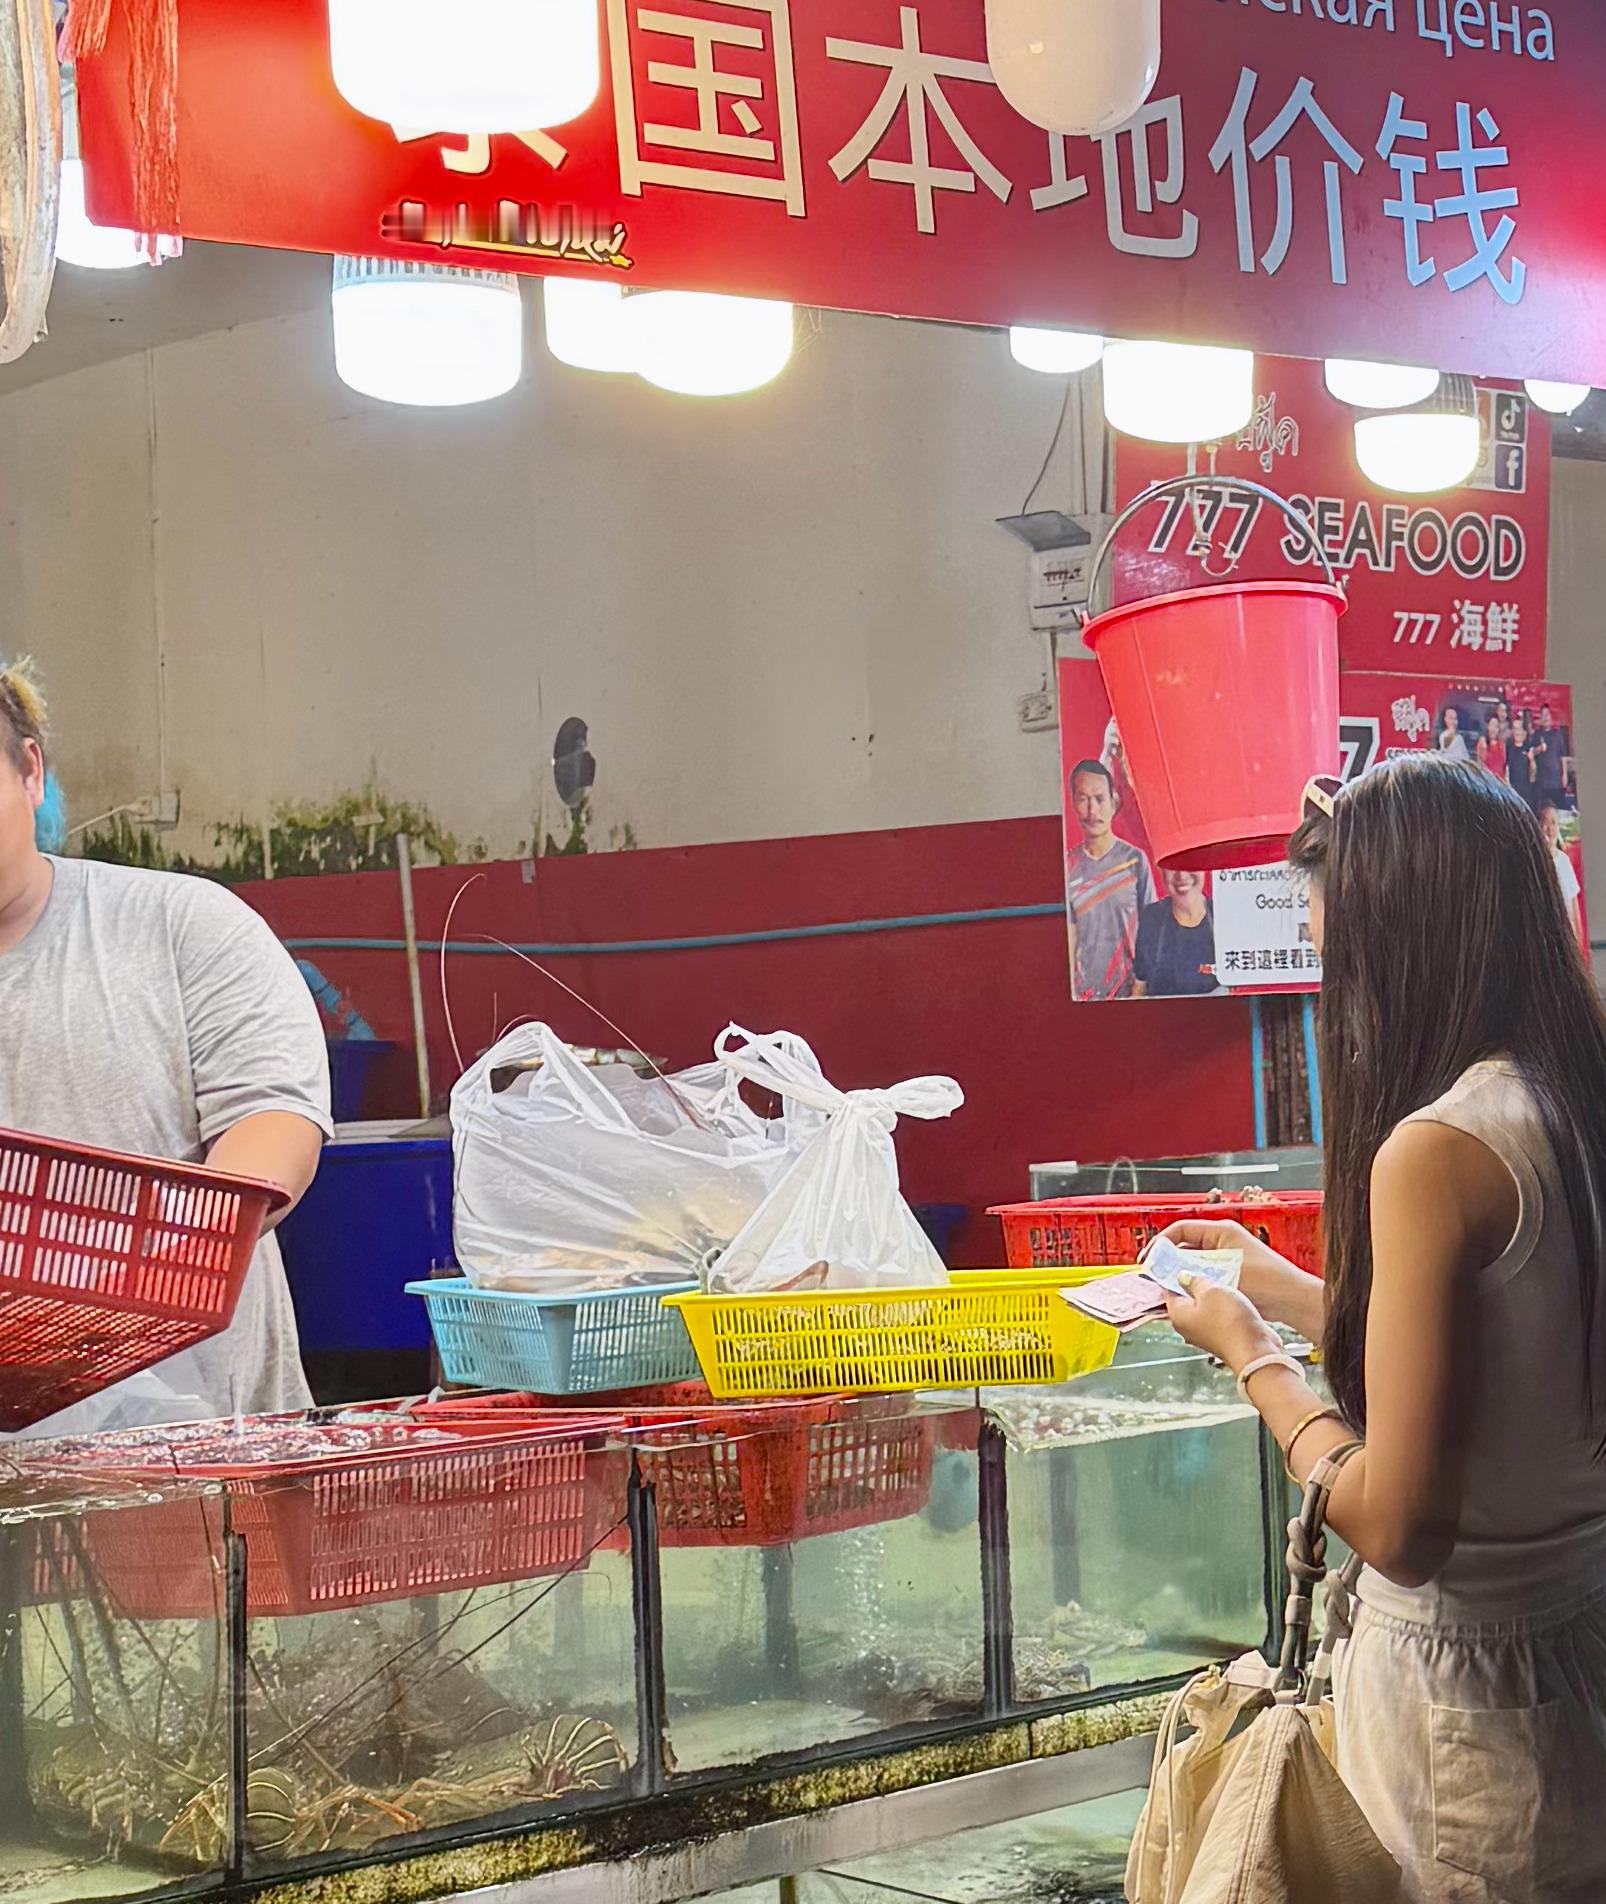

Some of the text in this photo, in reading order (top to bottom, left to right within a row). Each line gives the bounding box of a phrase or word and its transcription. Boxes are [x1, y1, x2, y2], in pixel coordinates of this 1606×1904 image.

[1147, 479, 1526, 581] 777 SEAFOOD
[1393, 598, 1520, 653] 777 海鮮
[1256, 893, 1293, 909] Good
